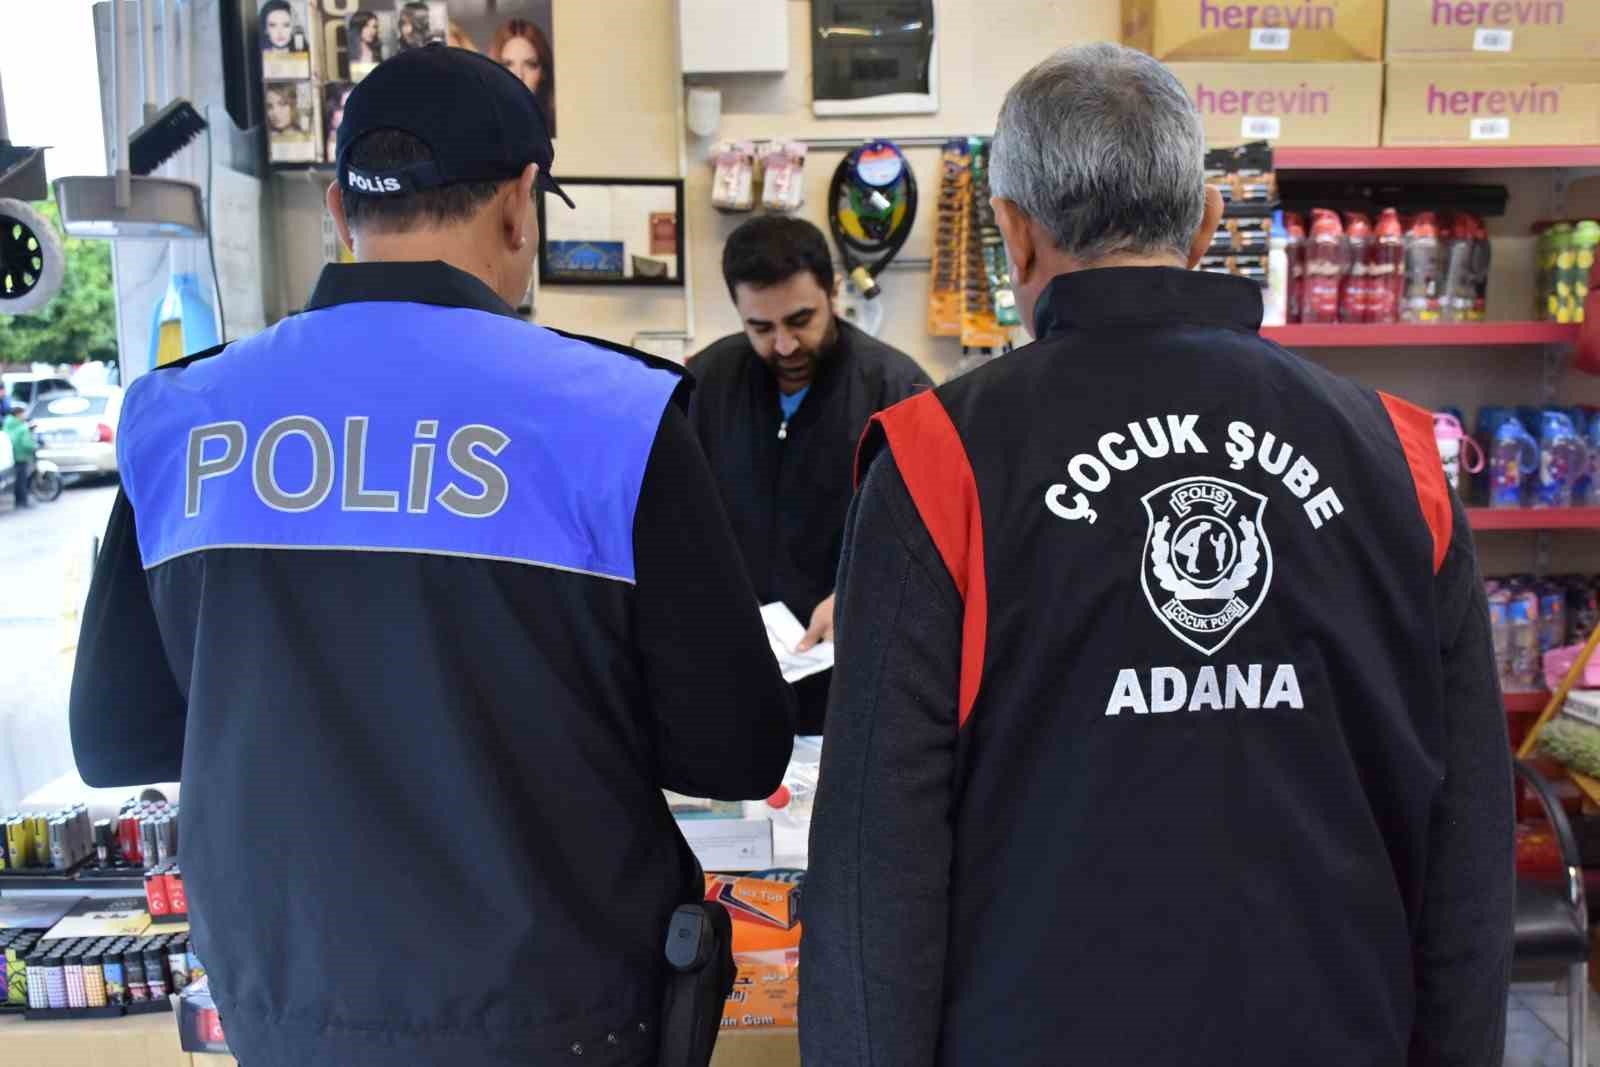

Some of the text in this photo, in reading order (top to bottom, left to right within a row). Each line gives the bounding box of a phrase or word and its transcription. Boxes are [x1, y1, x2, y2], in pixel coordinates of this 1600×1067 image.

[1200, 0, 1335, 29] herevin
[1432, 0, 1565, 26] herevin
[1196, 83, 1329, 114] herevin
[1427, 82, 1560, 114] herevin
[1044, 413, 1345, 530] ÇOCUK ŞUBE
[1105, 663, 1305, 716] ADANA
